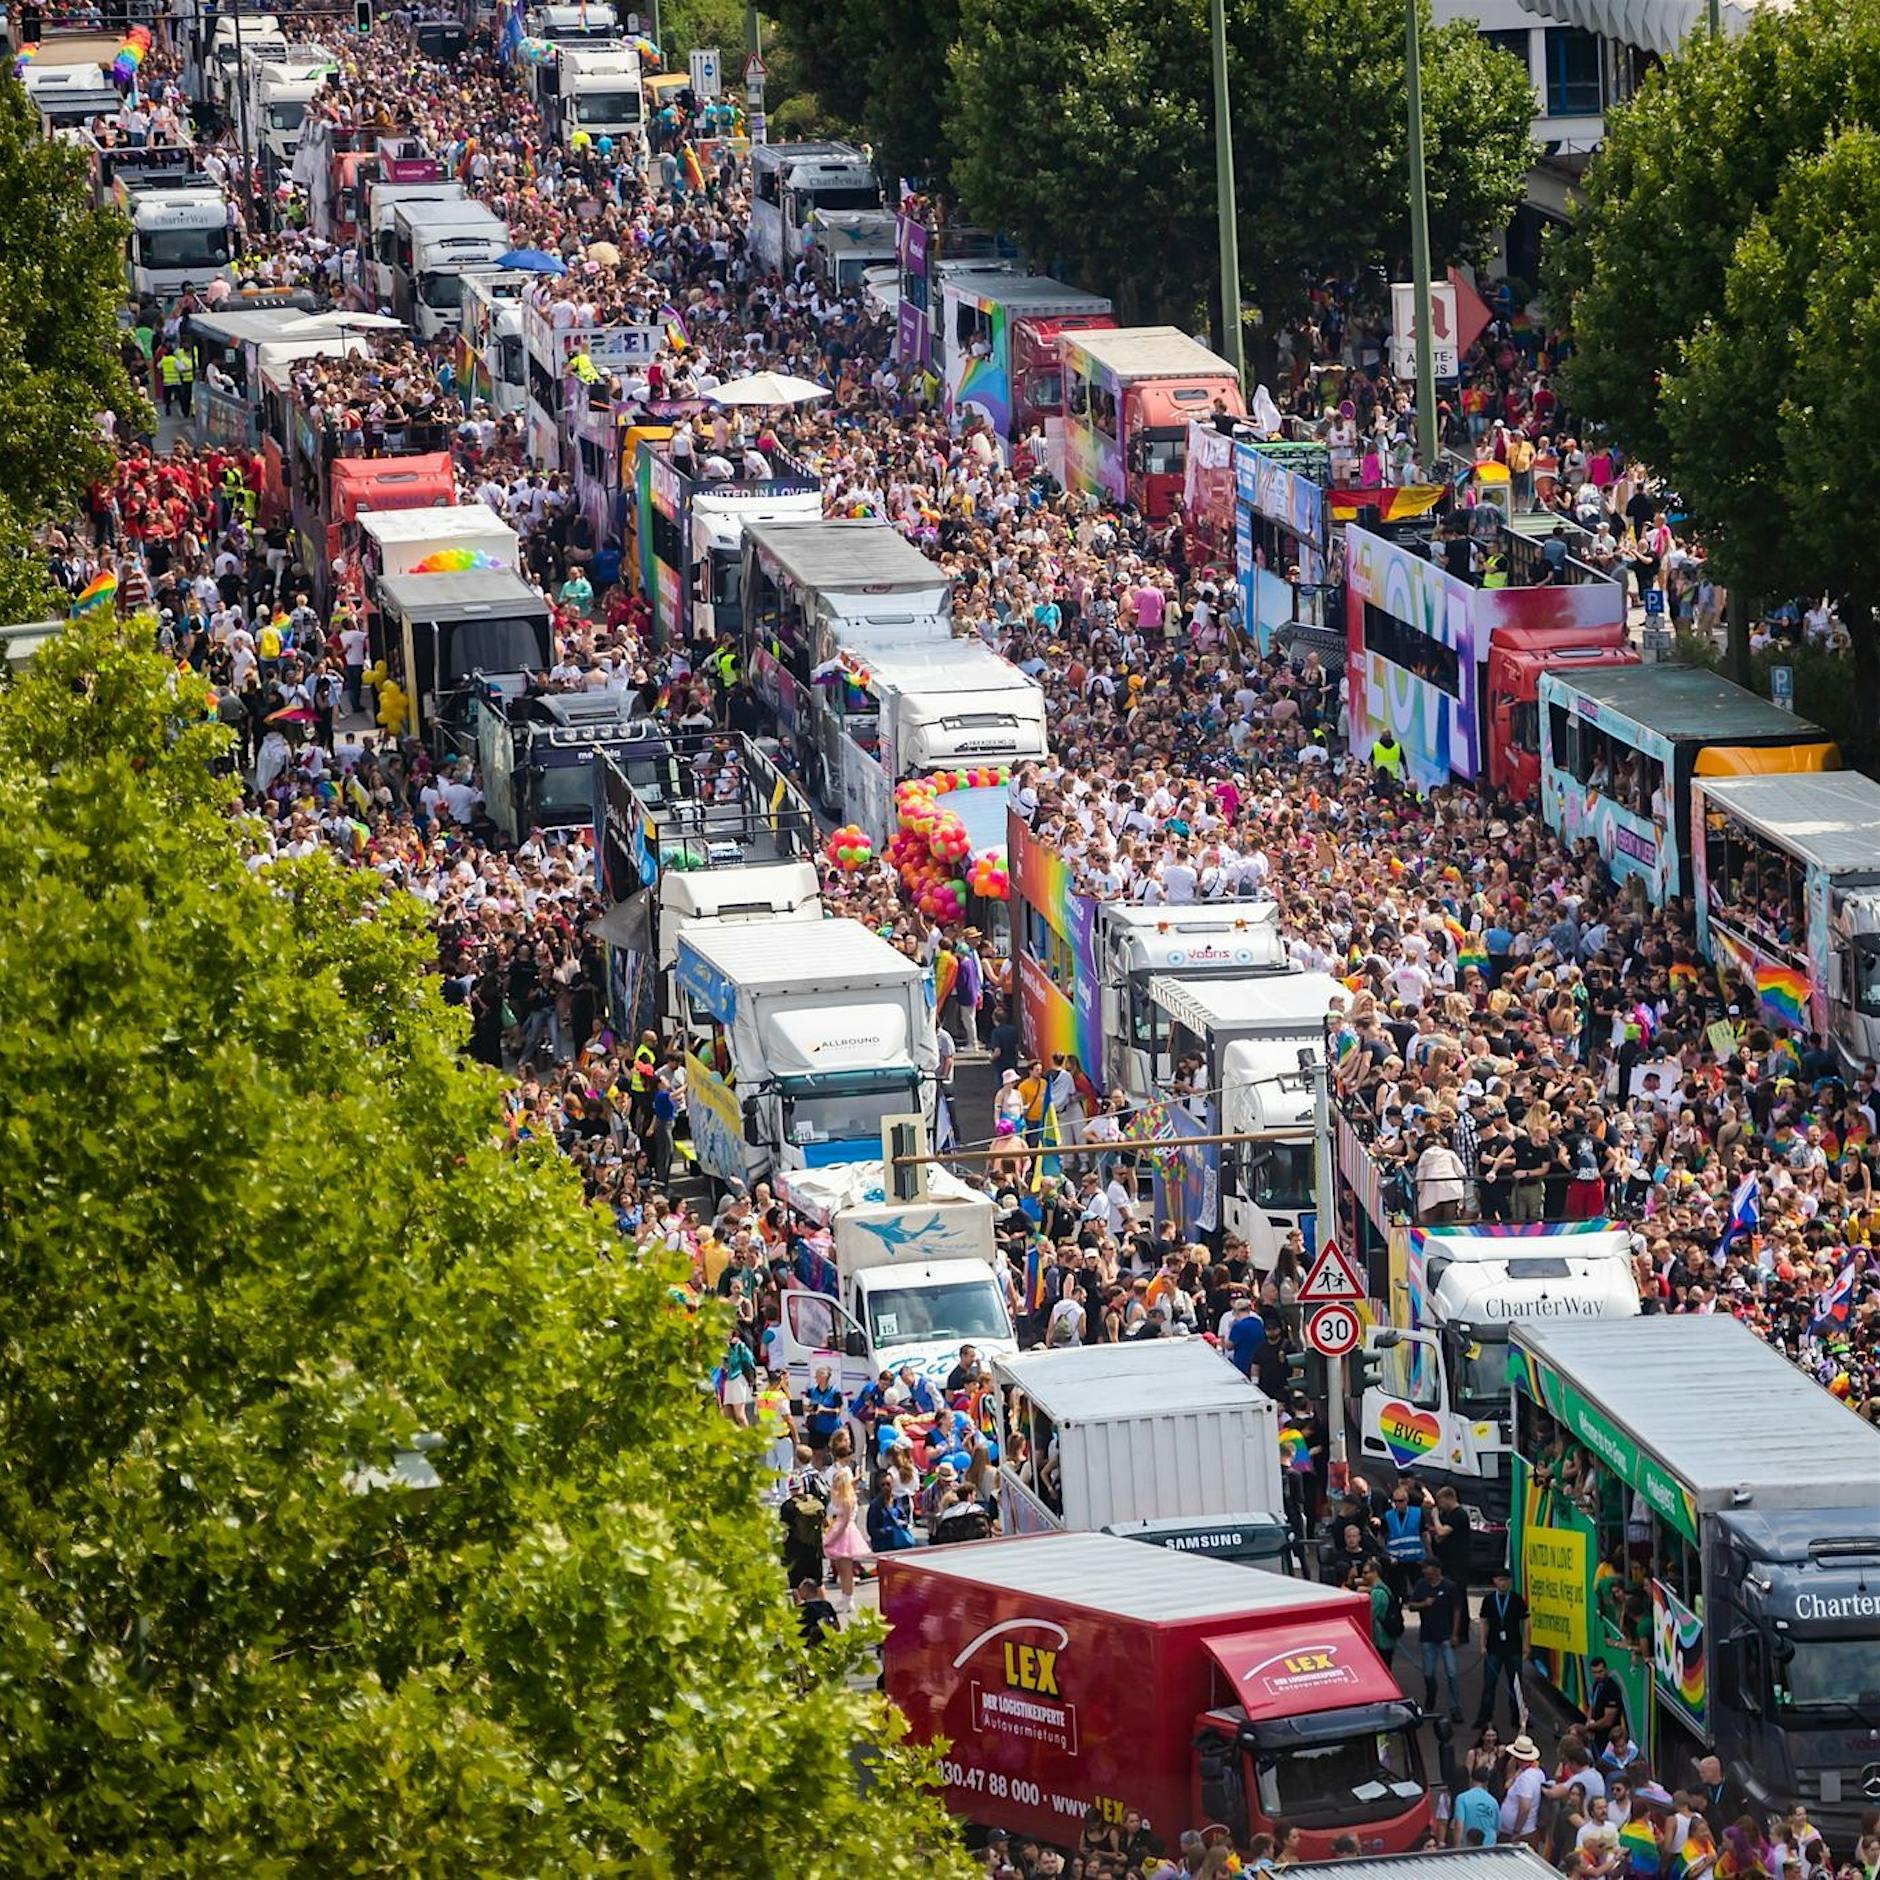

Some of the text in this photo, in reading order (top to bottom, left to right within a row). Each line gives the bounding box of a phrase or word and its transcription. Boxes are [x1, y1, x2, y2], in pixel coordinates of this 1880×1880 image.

[1648, 592, 1659, 604] P
[1775, 670, 1788, 691] P
[1486, 1295, 1604, 1320] CharterWay
[1321, 1319, 1348, 1342] 30
[1393, 1421, 1424, 1446] BVG
[1165, 1533, 1242, 1550] SAMSUNG
[1004, 1641, 1059, 1695] LEX
[1283, 1653, 1335, 1673] LEX
[981, 1692, 1065, 1727] DER LOGISTIKEXPERTE
[983, 1713, 1067, 1749] Autovermietung
[988, 1775, 1008, 1798] 88
[1011, 1778, 1040, 1806] 000
